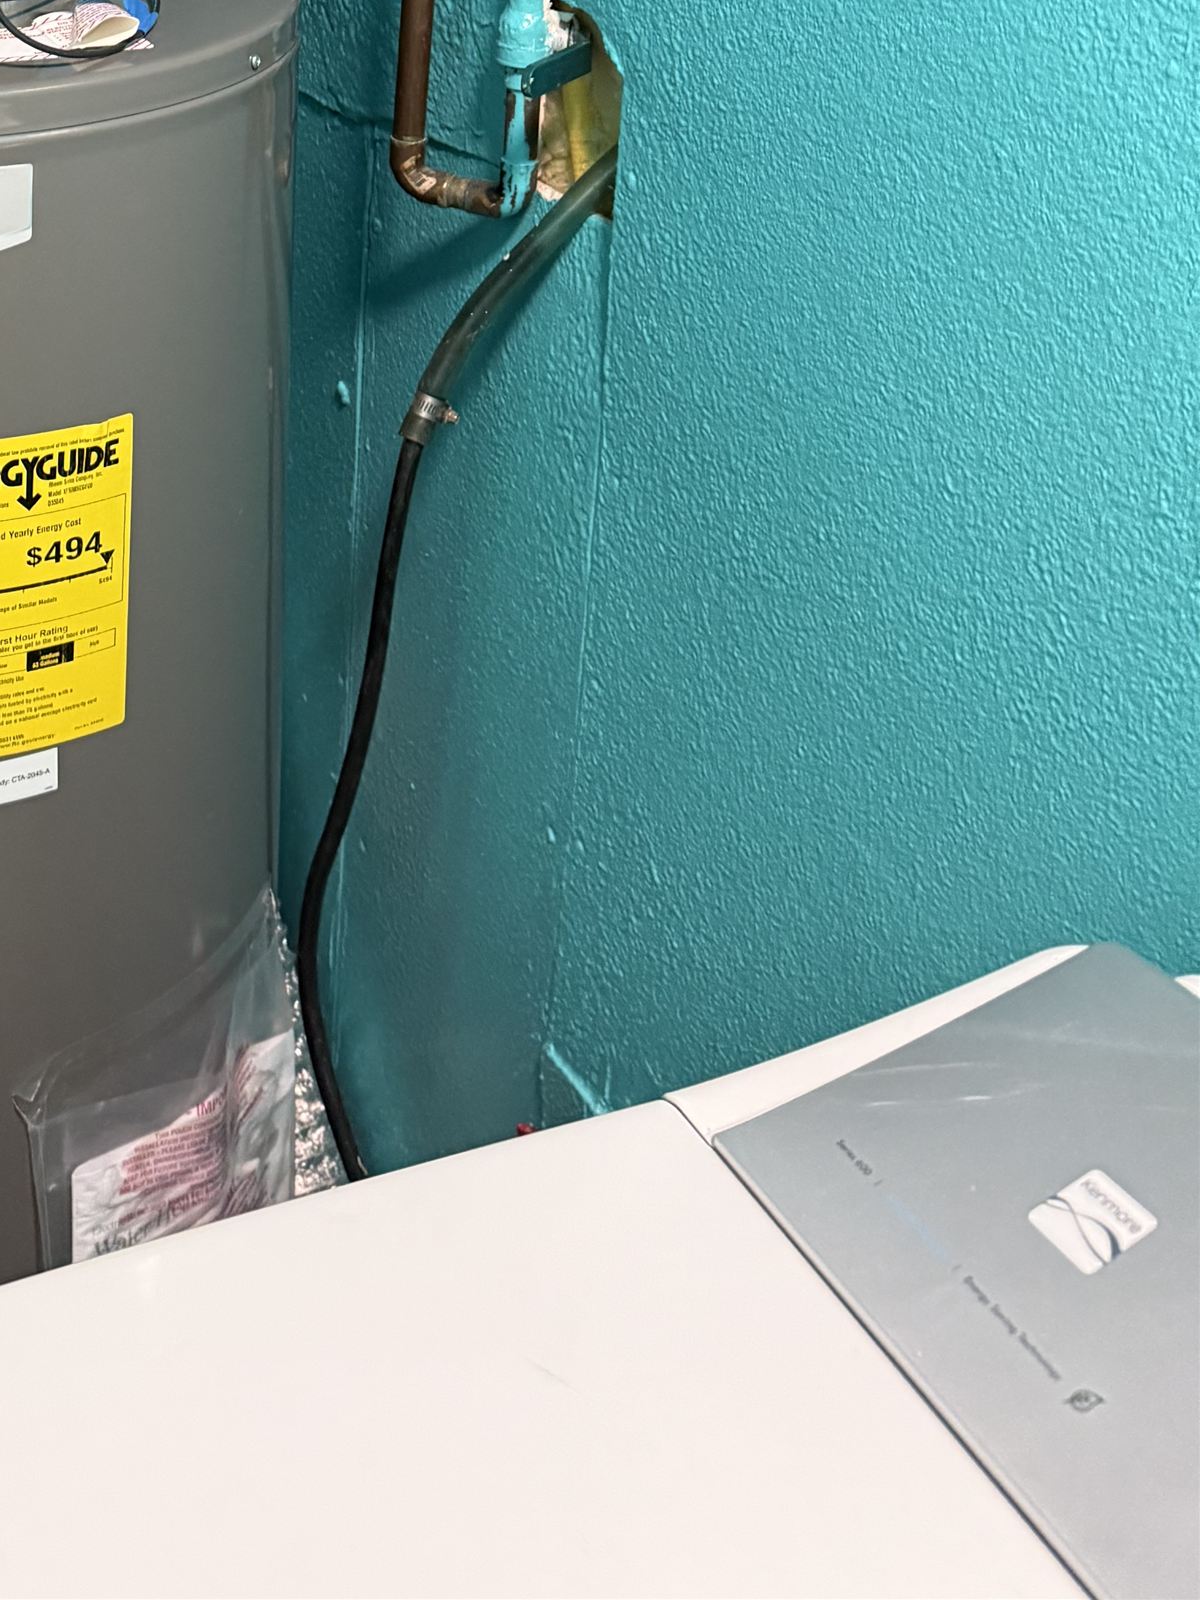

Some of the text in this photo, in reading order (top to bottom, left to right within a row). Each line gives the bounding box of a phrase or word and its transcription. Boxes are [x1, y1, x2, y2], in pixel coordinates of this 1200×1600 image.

[9, 528, 34, 539] Yearly
[36, 523, 63, 536] Energy
[65, 518, 81, 528] Cost
[27, 531, 103, 567] $494
[15, 632, 38, 643] Hour
[40, 625, 68, 638] Rating
[1080, 1177, 1143, 1235] Kenmore
